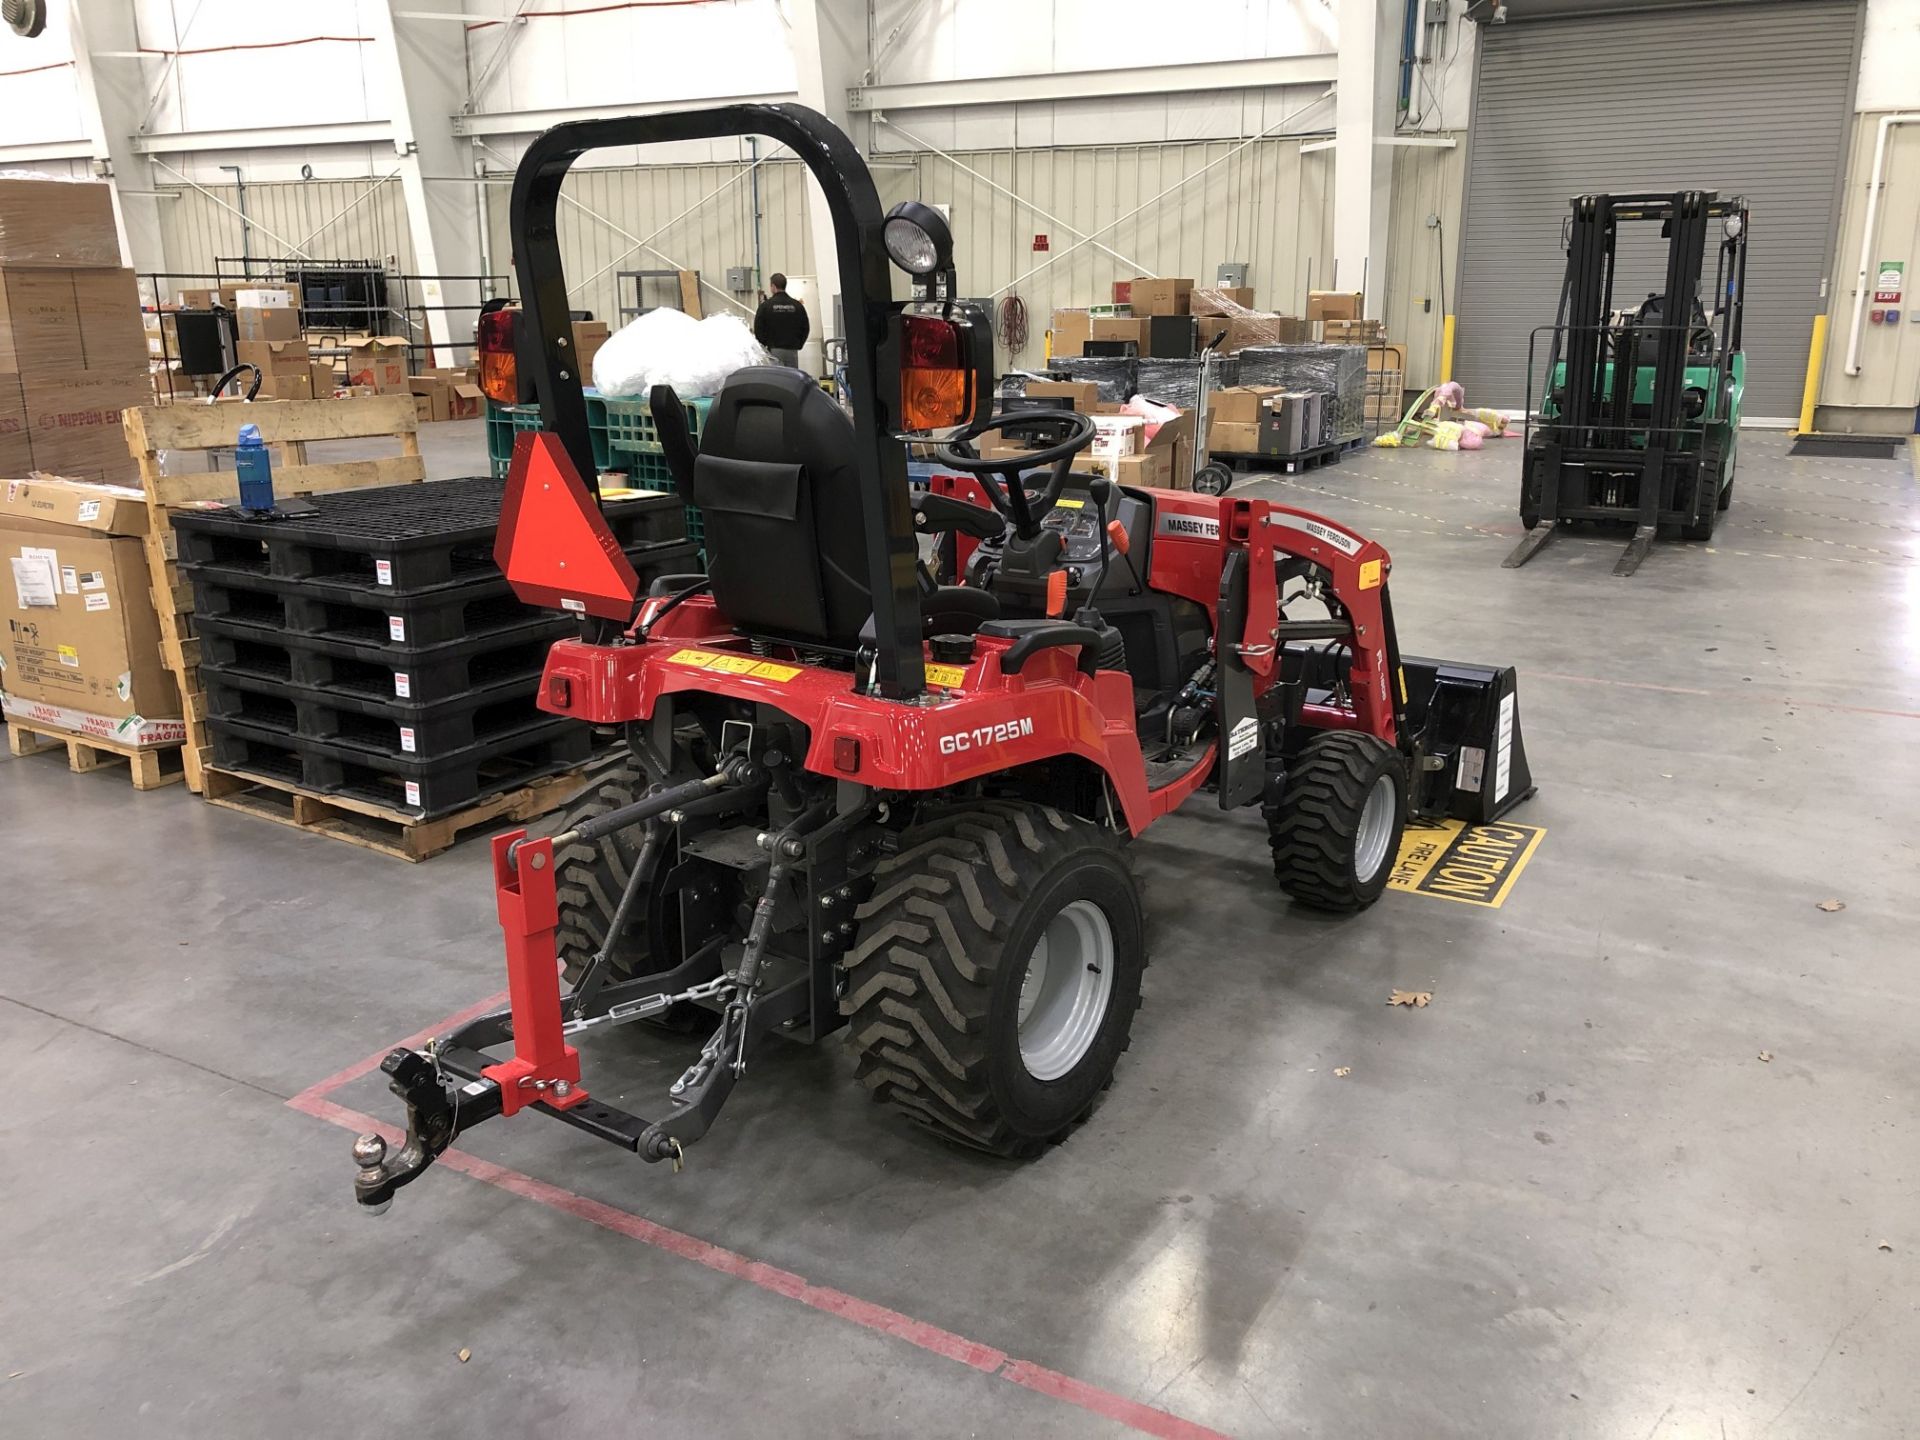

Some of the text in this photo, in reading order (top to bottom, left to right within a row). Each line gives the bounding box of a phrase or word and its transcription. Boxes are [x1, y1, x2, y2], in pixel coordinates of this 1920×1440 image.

[1877, 292, 1898, 300] EXIT
[58, 411, 103, 428] NIPPON
[1168, 519, 1204, 534] MASSEY
[1306, 522, 1351, 549] MASSEY FERGUSON
[34, 705, 61, 718] FRAGILE
[80, 723, 110, 737] FRAGILE
[86, 716, 116, 730] FRAGILE
[1388, 841, 1437, 886] FIRE LANE
[1429, 826, 1525, 897] CAUTION
